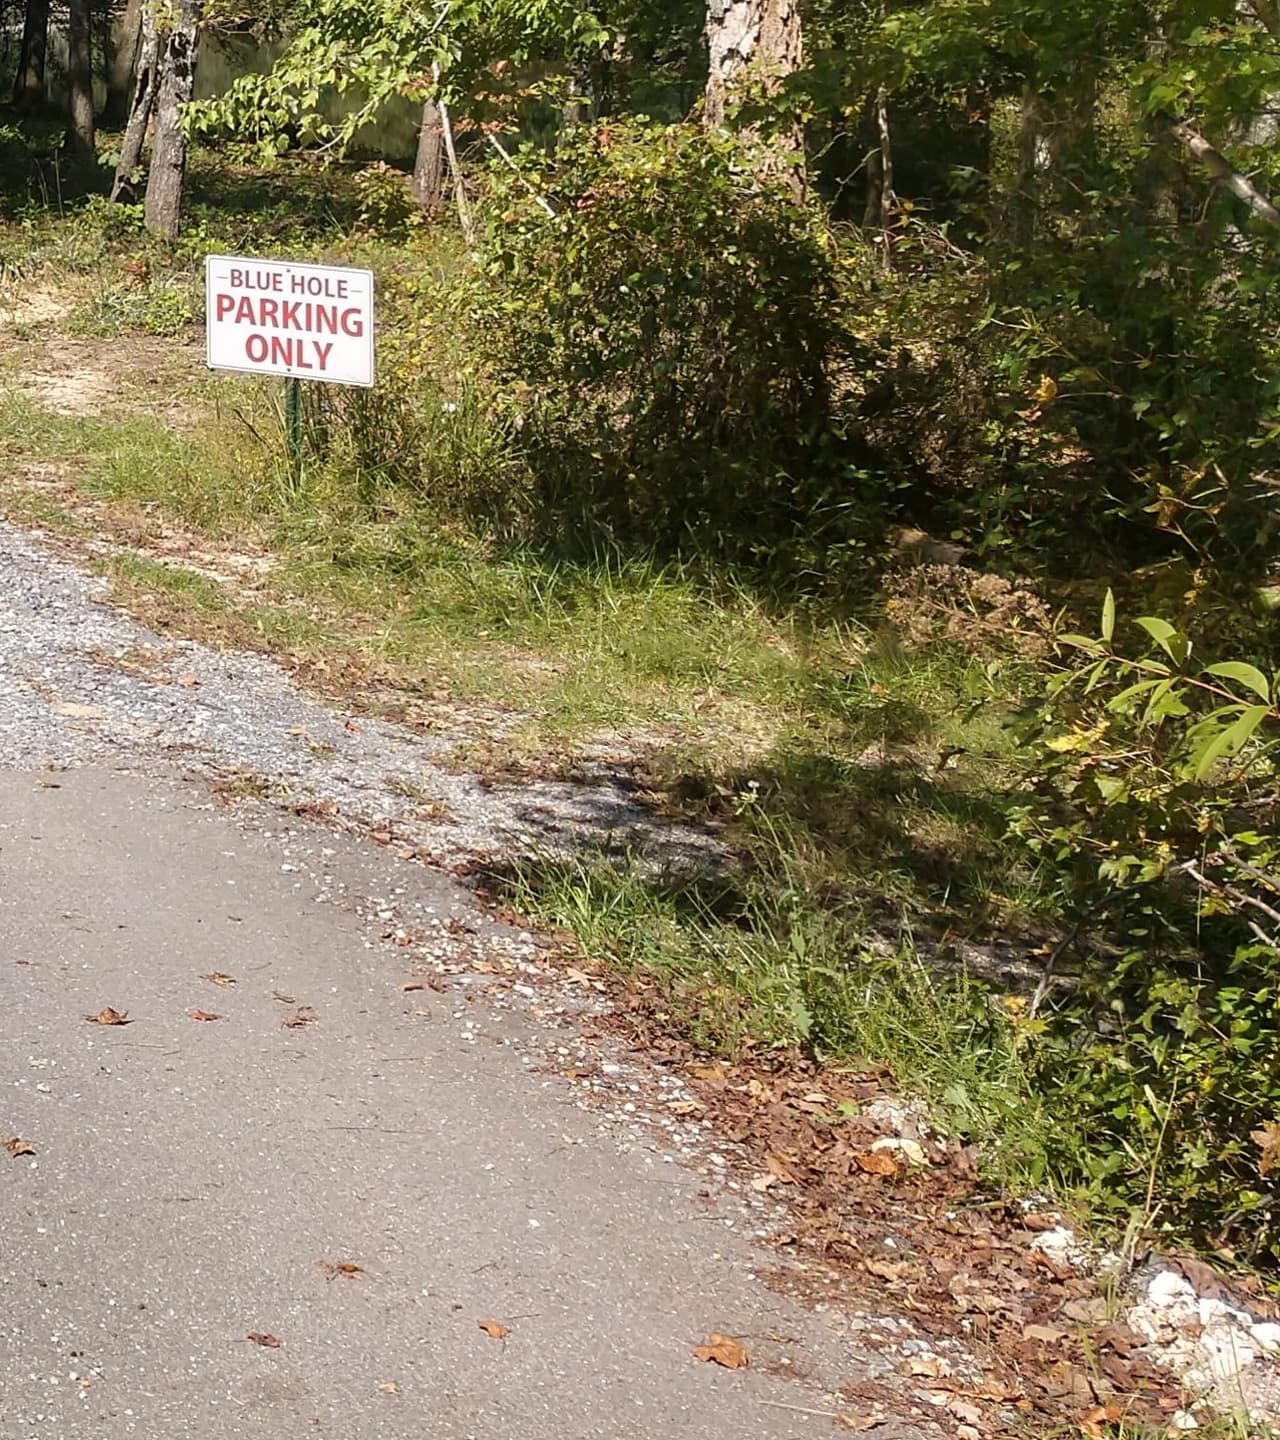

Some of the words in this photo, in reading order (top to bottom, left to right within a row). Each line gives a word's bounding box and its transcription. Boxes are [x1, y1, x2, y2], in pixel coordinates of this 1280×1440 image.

[230, 269, 283, 292] BLUE
[291, 275, 348, 299] HOLE
[216, 294, 363, 337] PARKING
[245, 334, 334, 371] ONLY
